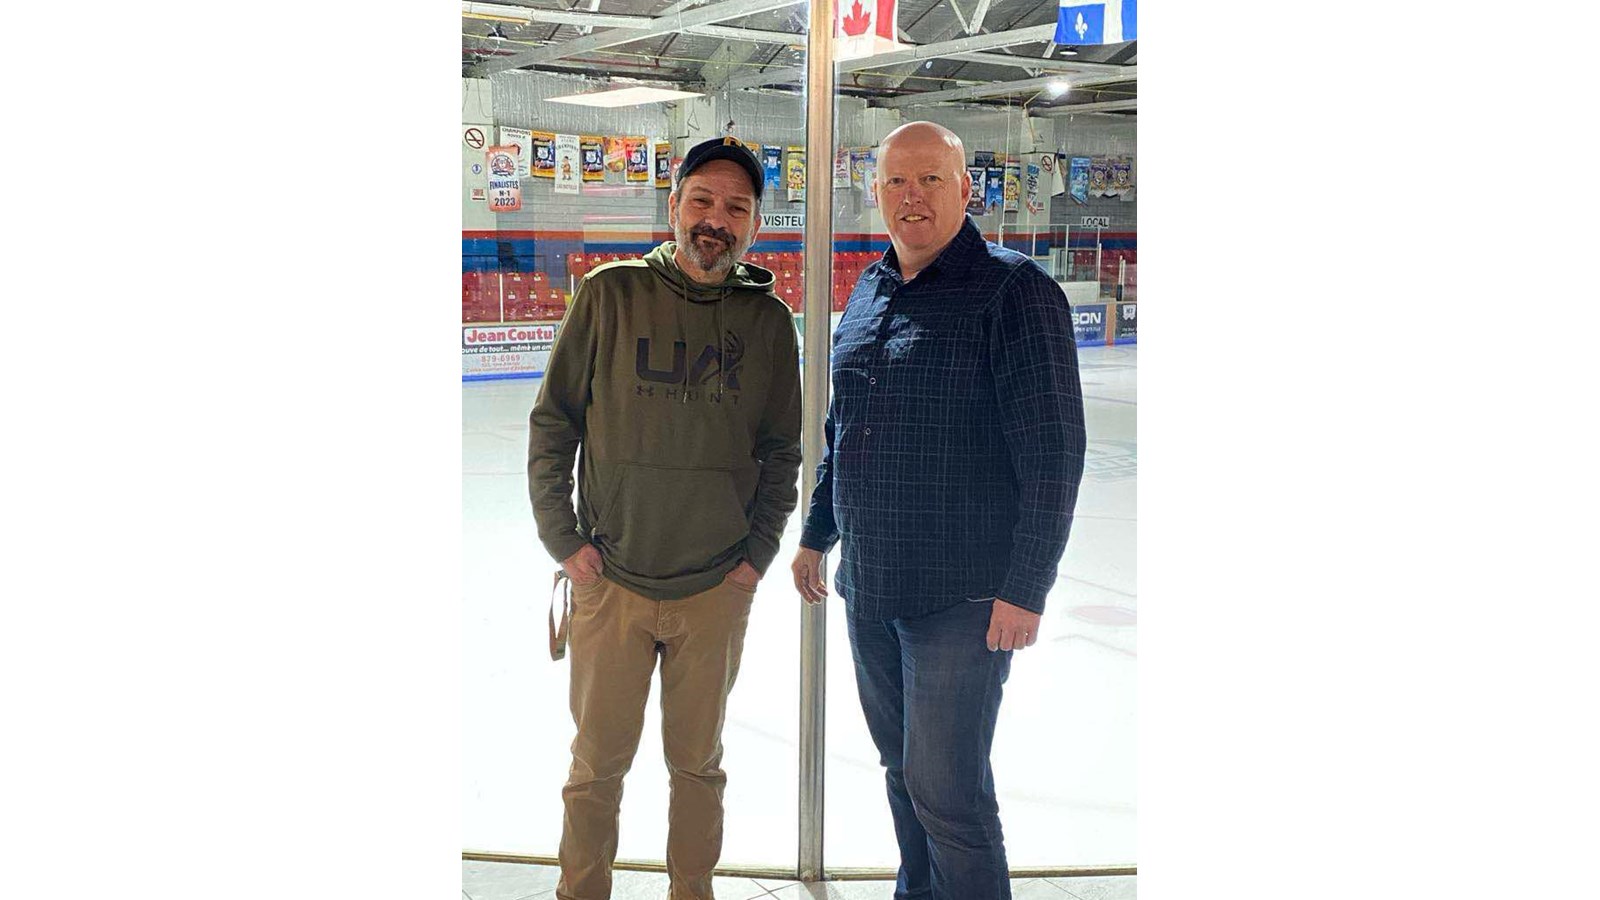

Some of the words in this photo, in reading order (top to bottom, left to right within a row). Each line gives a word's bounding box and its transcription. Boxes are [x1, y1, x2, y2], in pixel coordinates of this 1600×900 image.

[489, 180, 519, 190] FINALISTES
[494, 197, 516, 207] 2023
[1083, 218, 1108, 227] LOCAL
[467, 330, 506, 343] Jean
[508, 328, 552, 341] Coutu
[479, 345, 488, 353] de
[667, 389, 739, 404] HUNT
